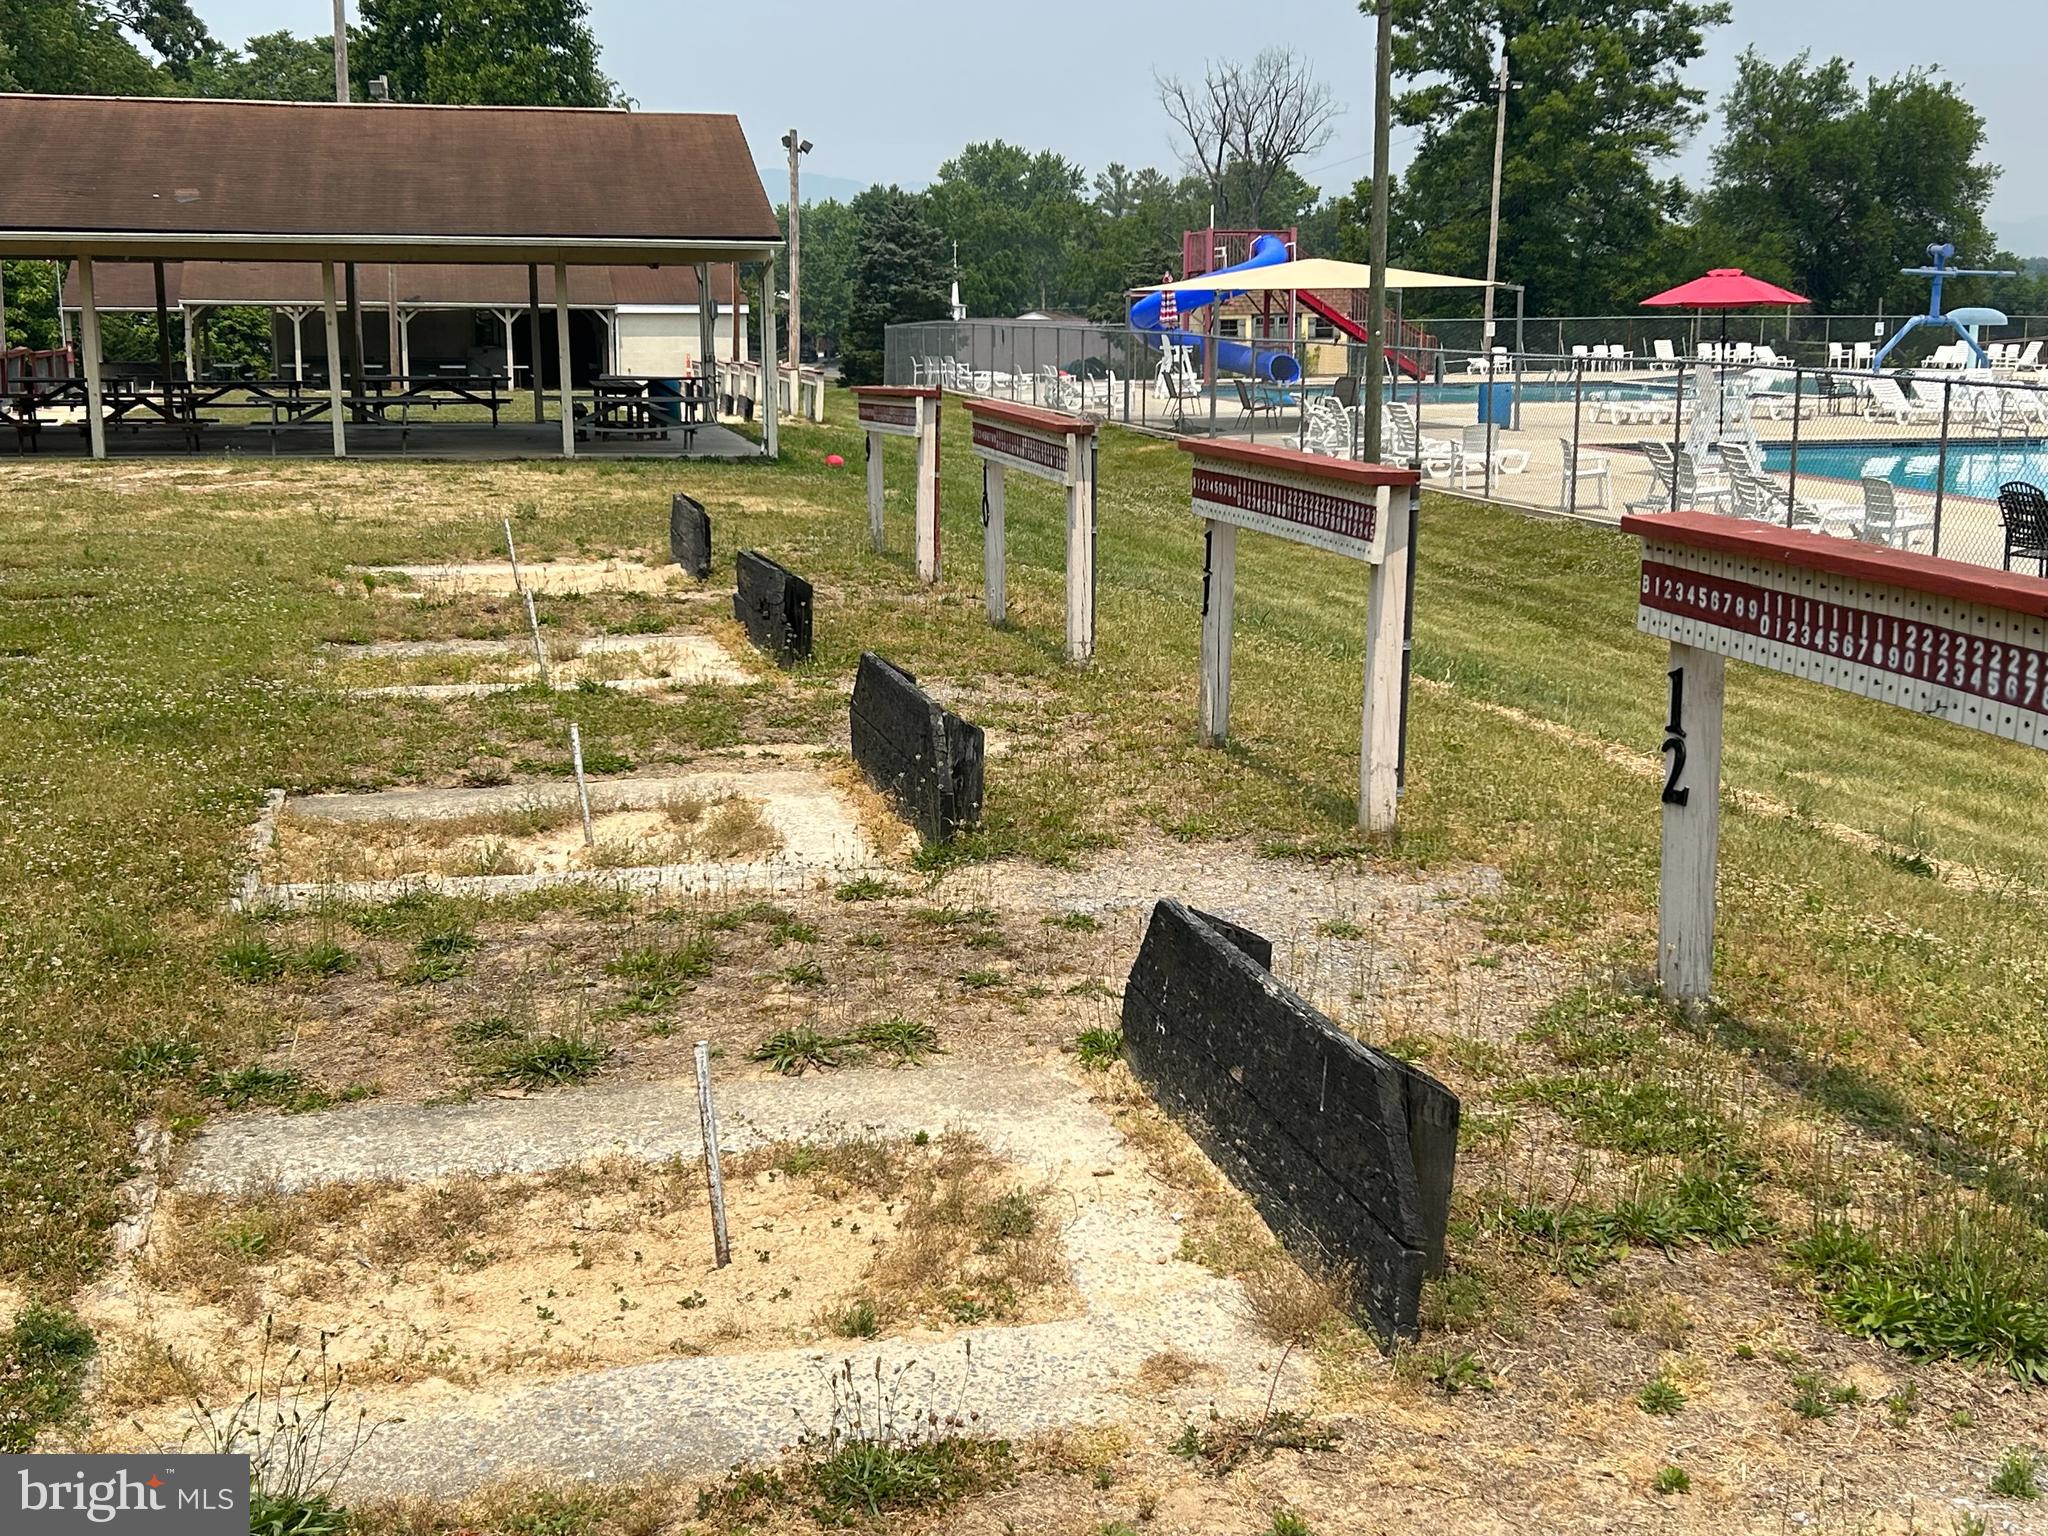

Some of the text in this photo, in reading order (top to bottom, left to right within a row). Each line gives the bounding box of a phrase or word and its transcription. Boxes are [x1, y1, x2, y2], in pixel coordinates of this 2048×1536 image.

[1642, 574, 1650, 593] B
[1654, 577, 1660, 596] 1
[1664, 579, 1672, 599] 2
[1675, 582, 1683, 602] 3
[1687, 585, 1695, 605] 4
[1698, 587, 1707, 608] 5
[1710, 590, 1719, 611] 6
[1723, 593, 1732, 614] 7
[1735, 596, 1745, 617] 8
[1748, 599, 1758, 620] 9
[1661, 667, 1689, 806] 12
